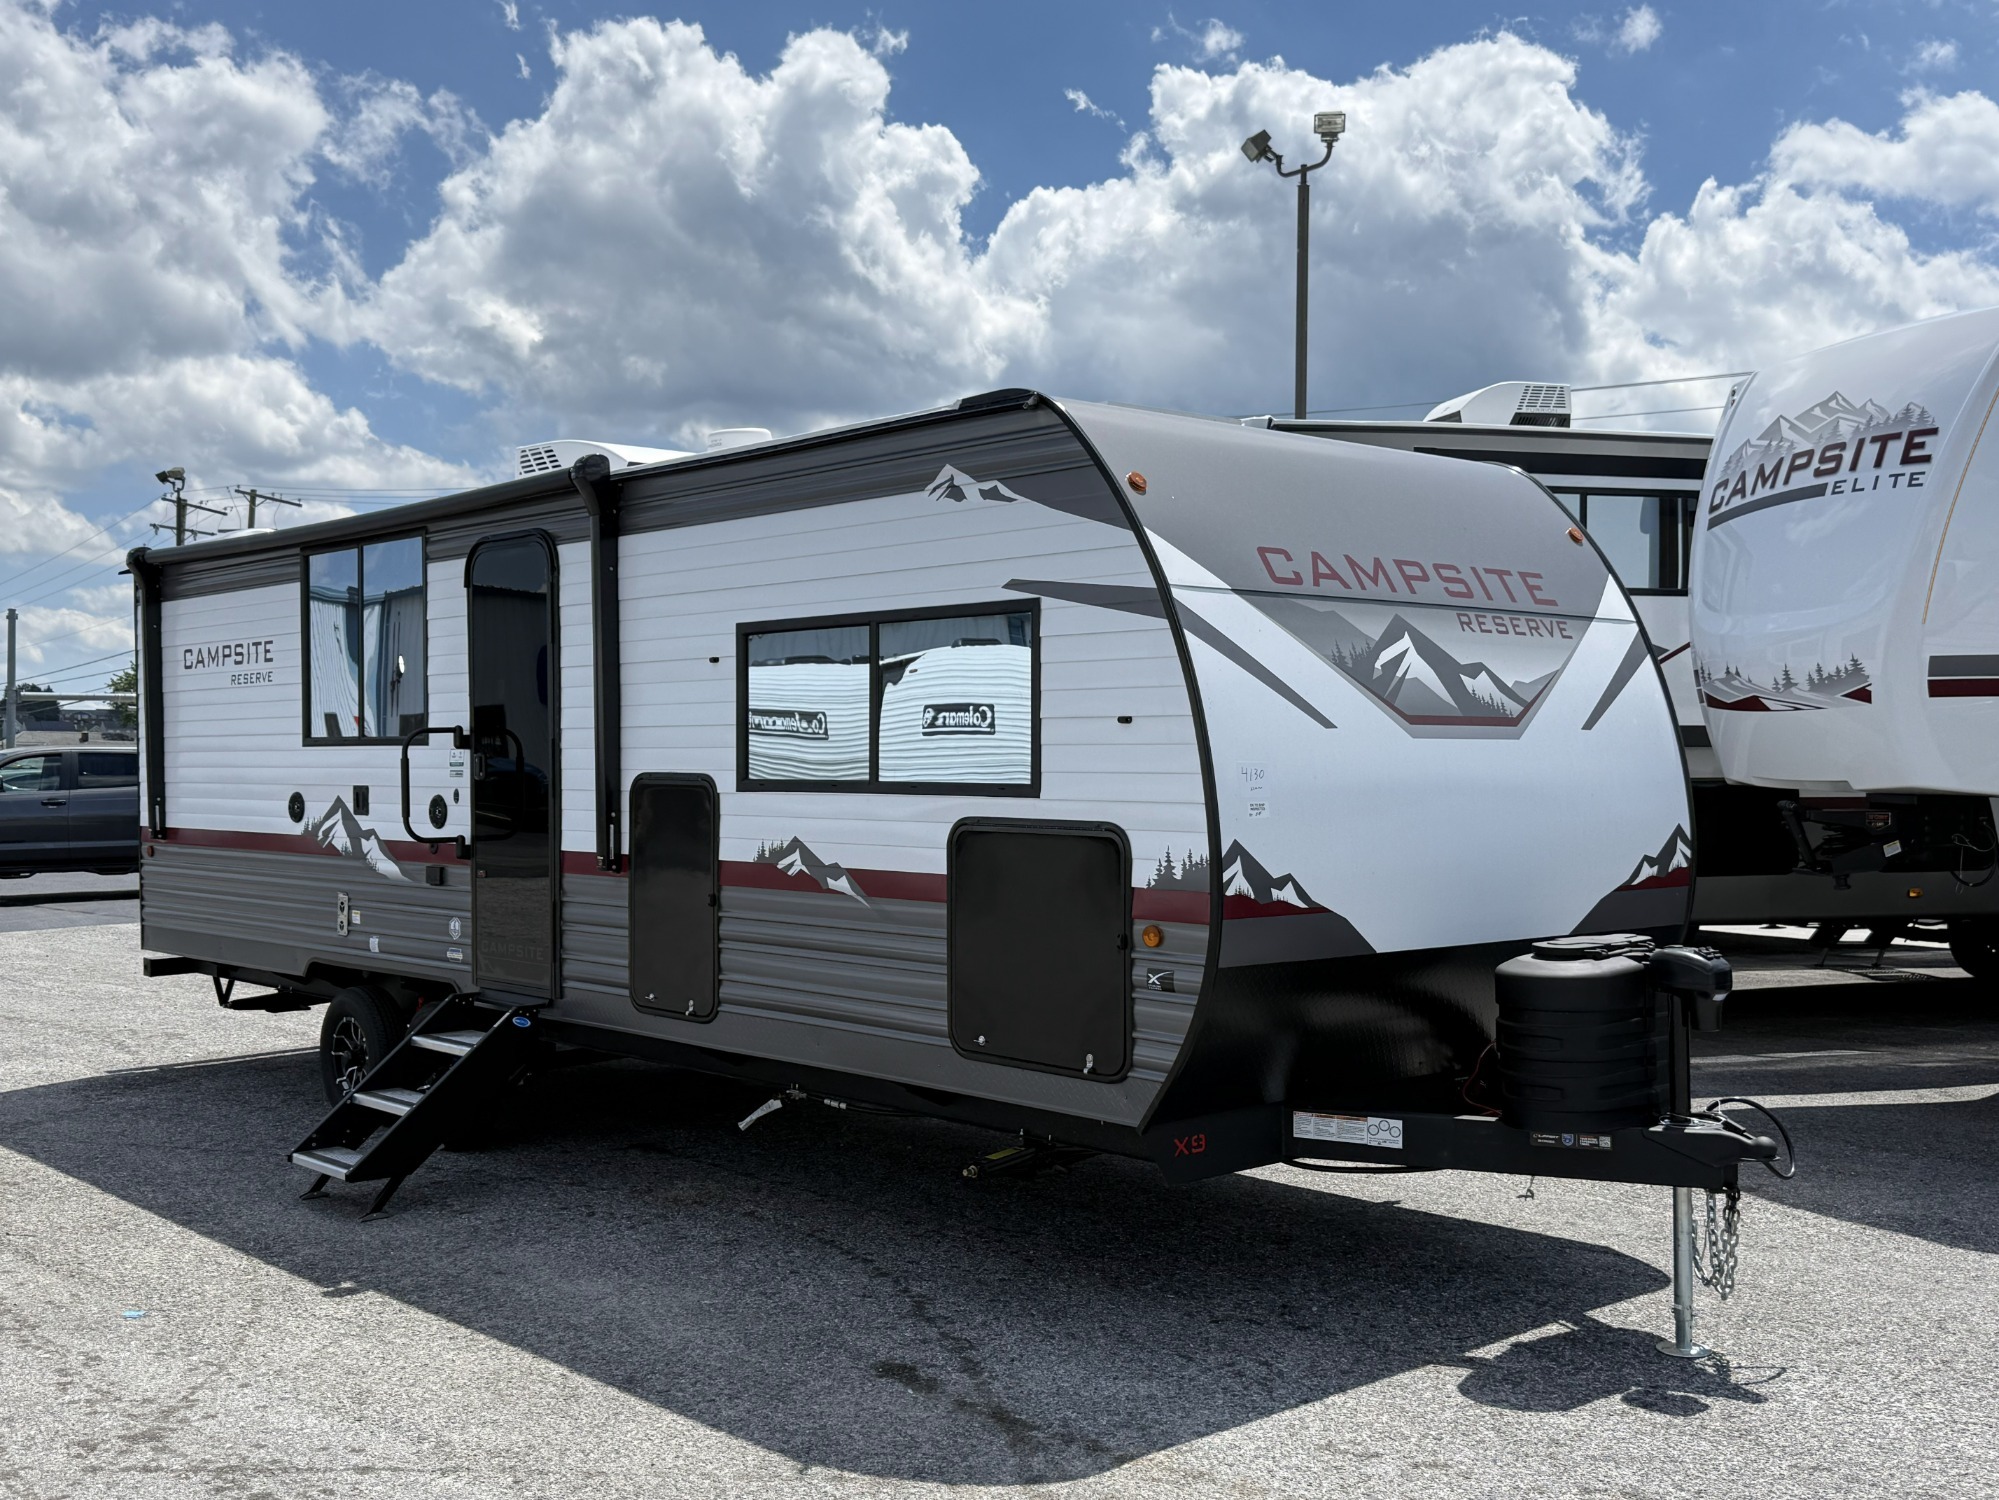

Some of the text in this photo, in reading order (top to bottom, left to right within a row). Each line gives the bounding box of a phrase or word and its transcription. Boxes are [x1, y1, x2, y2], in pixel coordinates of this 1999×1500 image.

[1708, 426, 1940, 515] CAMPSITE
[1830, 471, 1926, 496] ELITE
[1256, 546, 1559, 607] CAMPSITE
[1455, 612, 1574, 640] RESERVE
[183, 640, 274, 670] CAMPSITE
[230, 671, 274, 686] RESERVE
[1241, 766, 1265, 782] 4130
[480, 940, 545, 960] CAMPSITE
